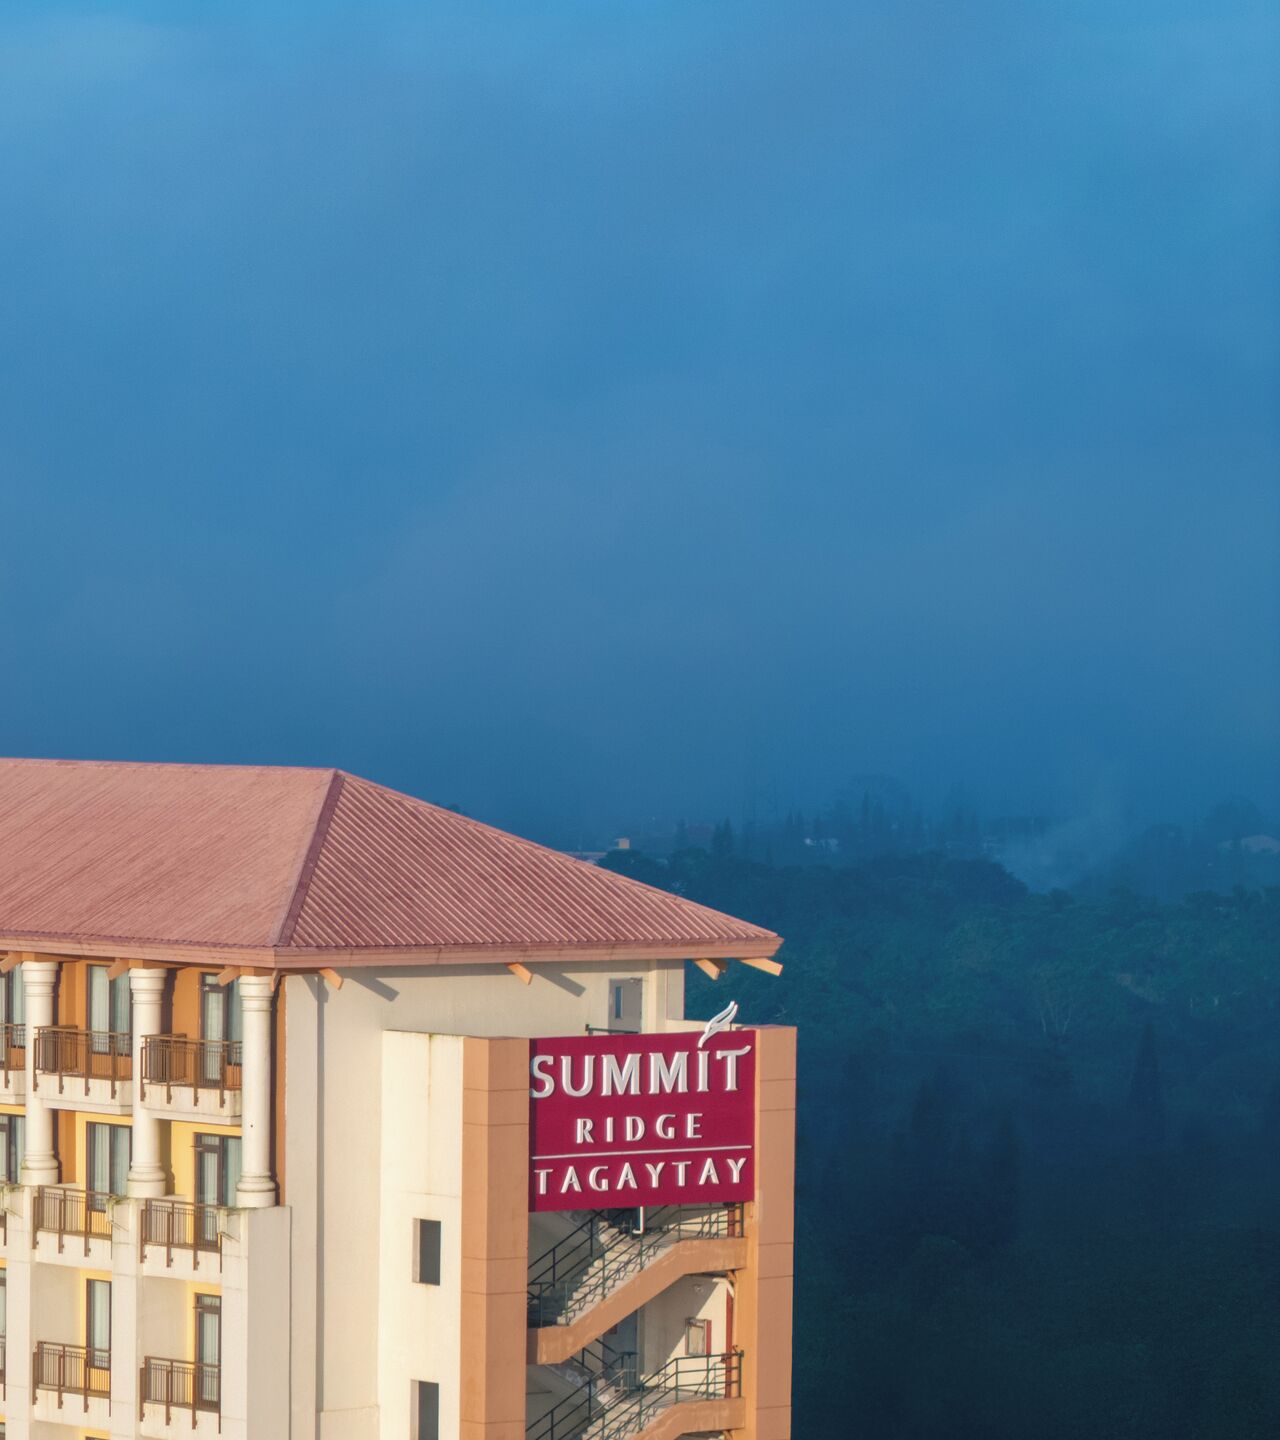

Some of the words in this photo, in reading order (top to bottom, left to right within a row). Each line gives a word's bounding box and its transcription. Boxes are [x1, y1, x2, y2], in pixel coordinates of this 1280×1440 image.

[530, 1045, 752, 1099] SUMMIT
[576, 1113, 704, 1145] RIDGE
[534, 1157, 747, 1195] TAGAYTAY
